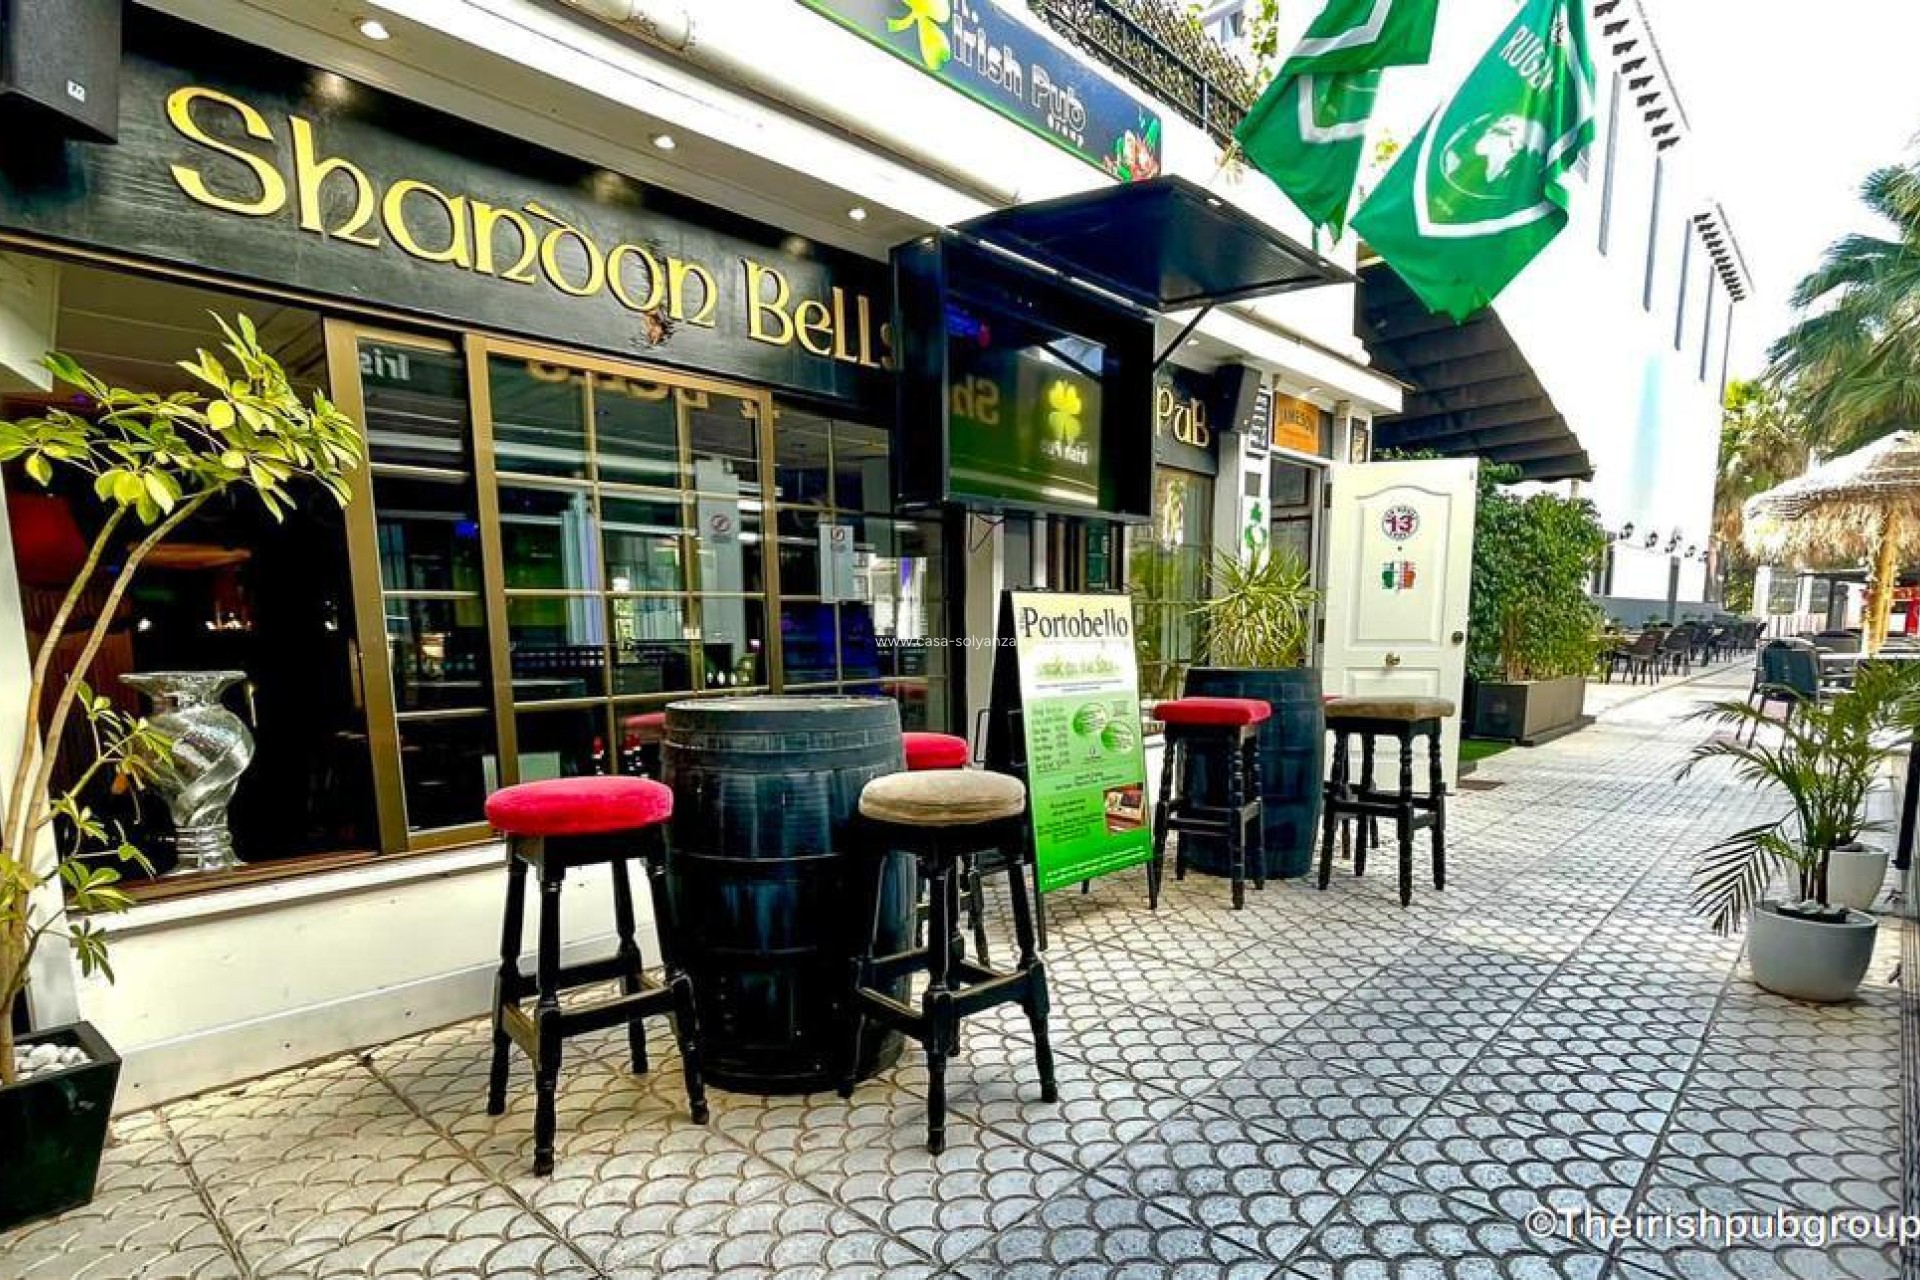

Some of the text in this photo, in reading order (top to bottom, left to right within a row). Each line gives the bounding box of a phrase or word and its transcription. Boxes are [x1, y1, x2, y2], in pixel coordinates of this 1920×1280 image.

[953, 14, 1023, 98] Irish
[1031, 63, 1087, 132] Pub
[166, 86, 719, 328] Shandon
[1023, 607, 1128, 638] Portobello
